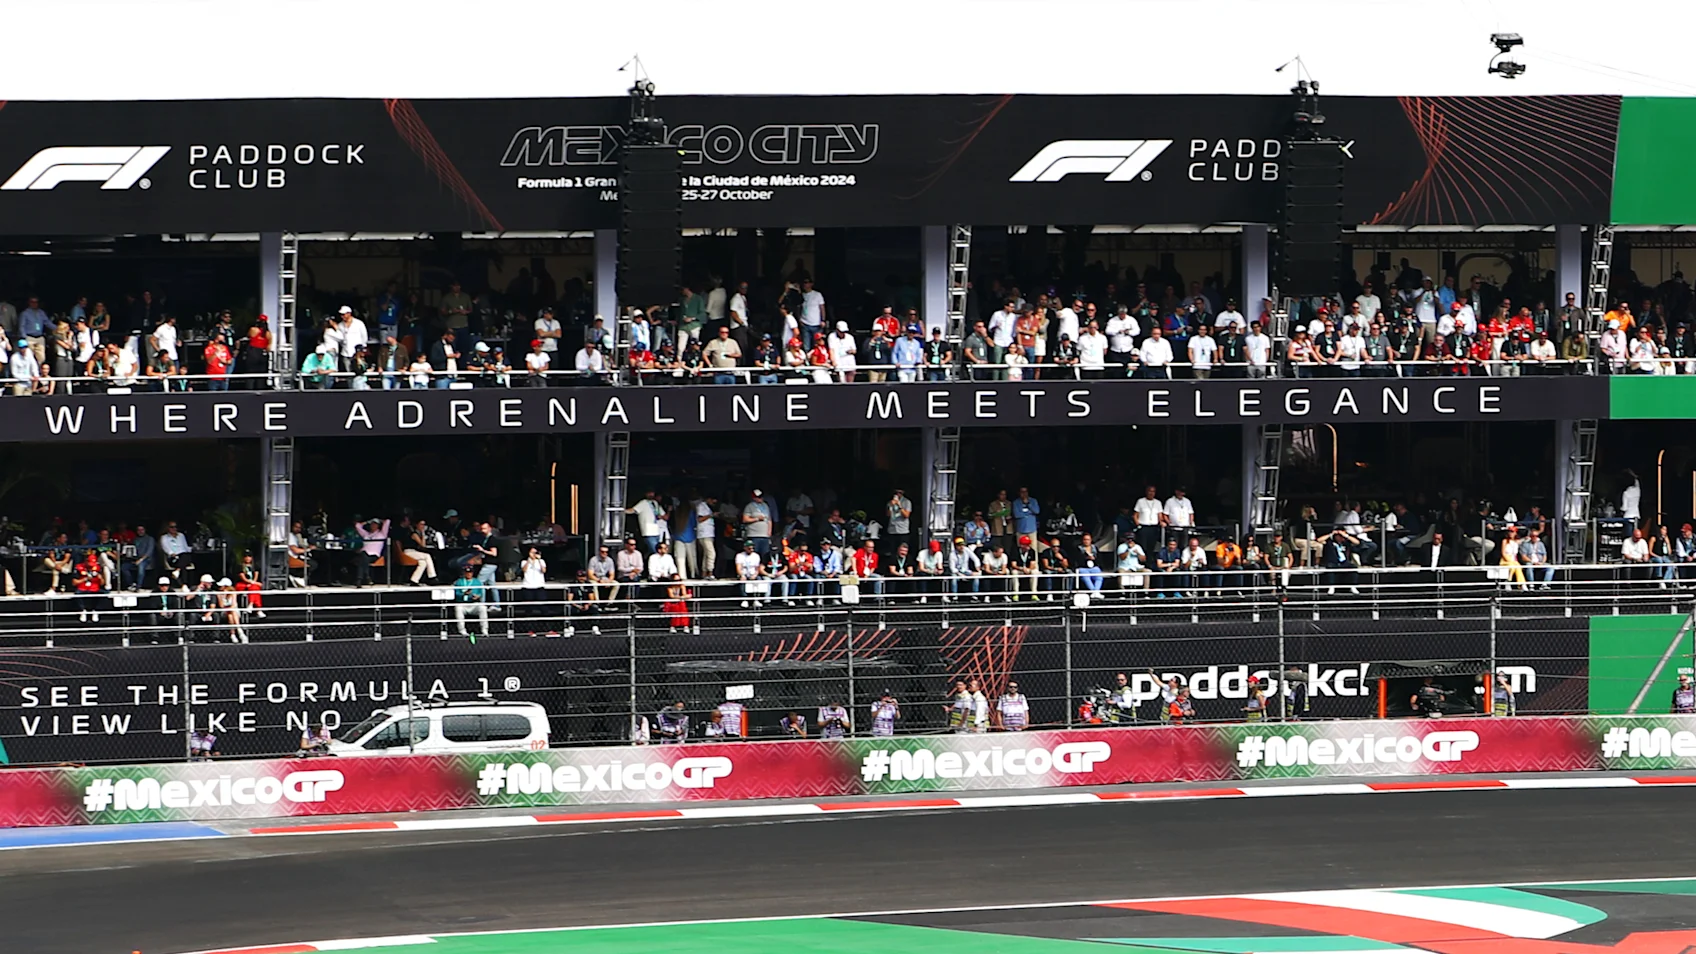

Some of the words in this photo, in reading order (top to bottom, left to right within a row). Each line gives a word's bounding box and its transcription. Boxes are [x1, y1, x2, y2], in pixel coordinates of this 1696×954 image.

[189, 144, 364, 165] PADDOCK
[500, 124, 744, 166] MEXCO
[749, 123, 880, 165] CITY
[1188, 138, 1355, 159] PADDK
[188, 167, 286, 189] CLUB
[517, 176, 573, 189] Formula
[574, 176, 583, 187] 1
[585, 176, 617, 188] Gran
[689, 175, 702, 187] la
[703, 174, 749, 187] Ciudad
[750, 174, 768, 187] de
[769, 173, 818, 187] México
[819, 174, 856, 186] 2024
[1188, 162, 1281, 182] CLUB
[682, 189, 717, 200] 25-27
[719, 188, 773, 201] October
[44, 402, 289, 434] WHERE
[345, 392, 812, 430] ADRENALINE
[866, 389, 1091, 420] MEETS
[1147, 386, 1501, 418] ELEGANCE
[20, 685, 99, 708] SEE
[127, 684, 209, 706] THE
[238, 679, 449, 704] FORMULA
[20, 714, 132, 736] VIEW
[161, 712, 257, 735] LIKE
[285, 709, 342, 731] NO
[861, 740, 1112, 782] #MexicoGP
[1236, 730, 1480, 768] #MexicoGP
[477, 755, 733, 796] #MexicoGP
[83, 769, 345, 813] #MexicoGP
